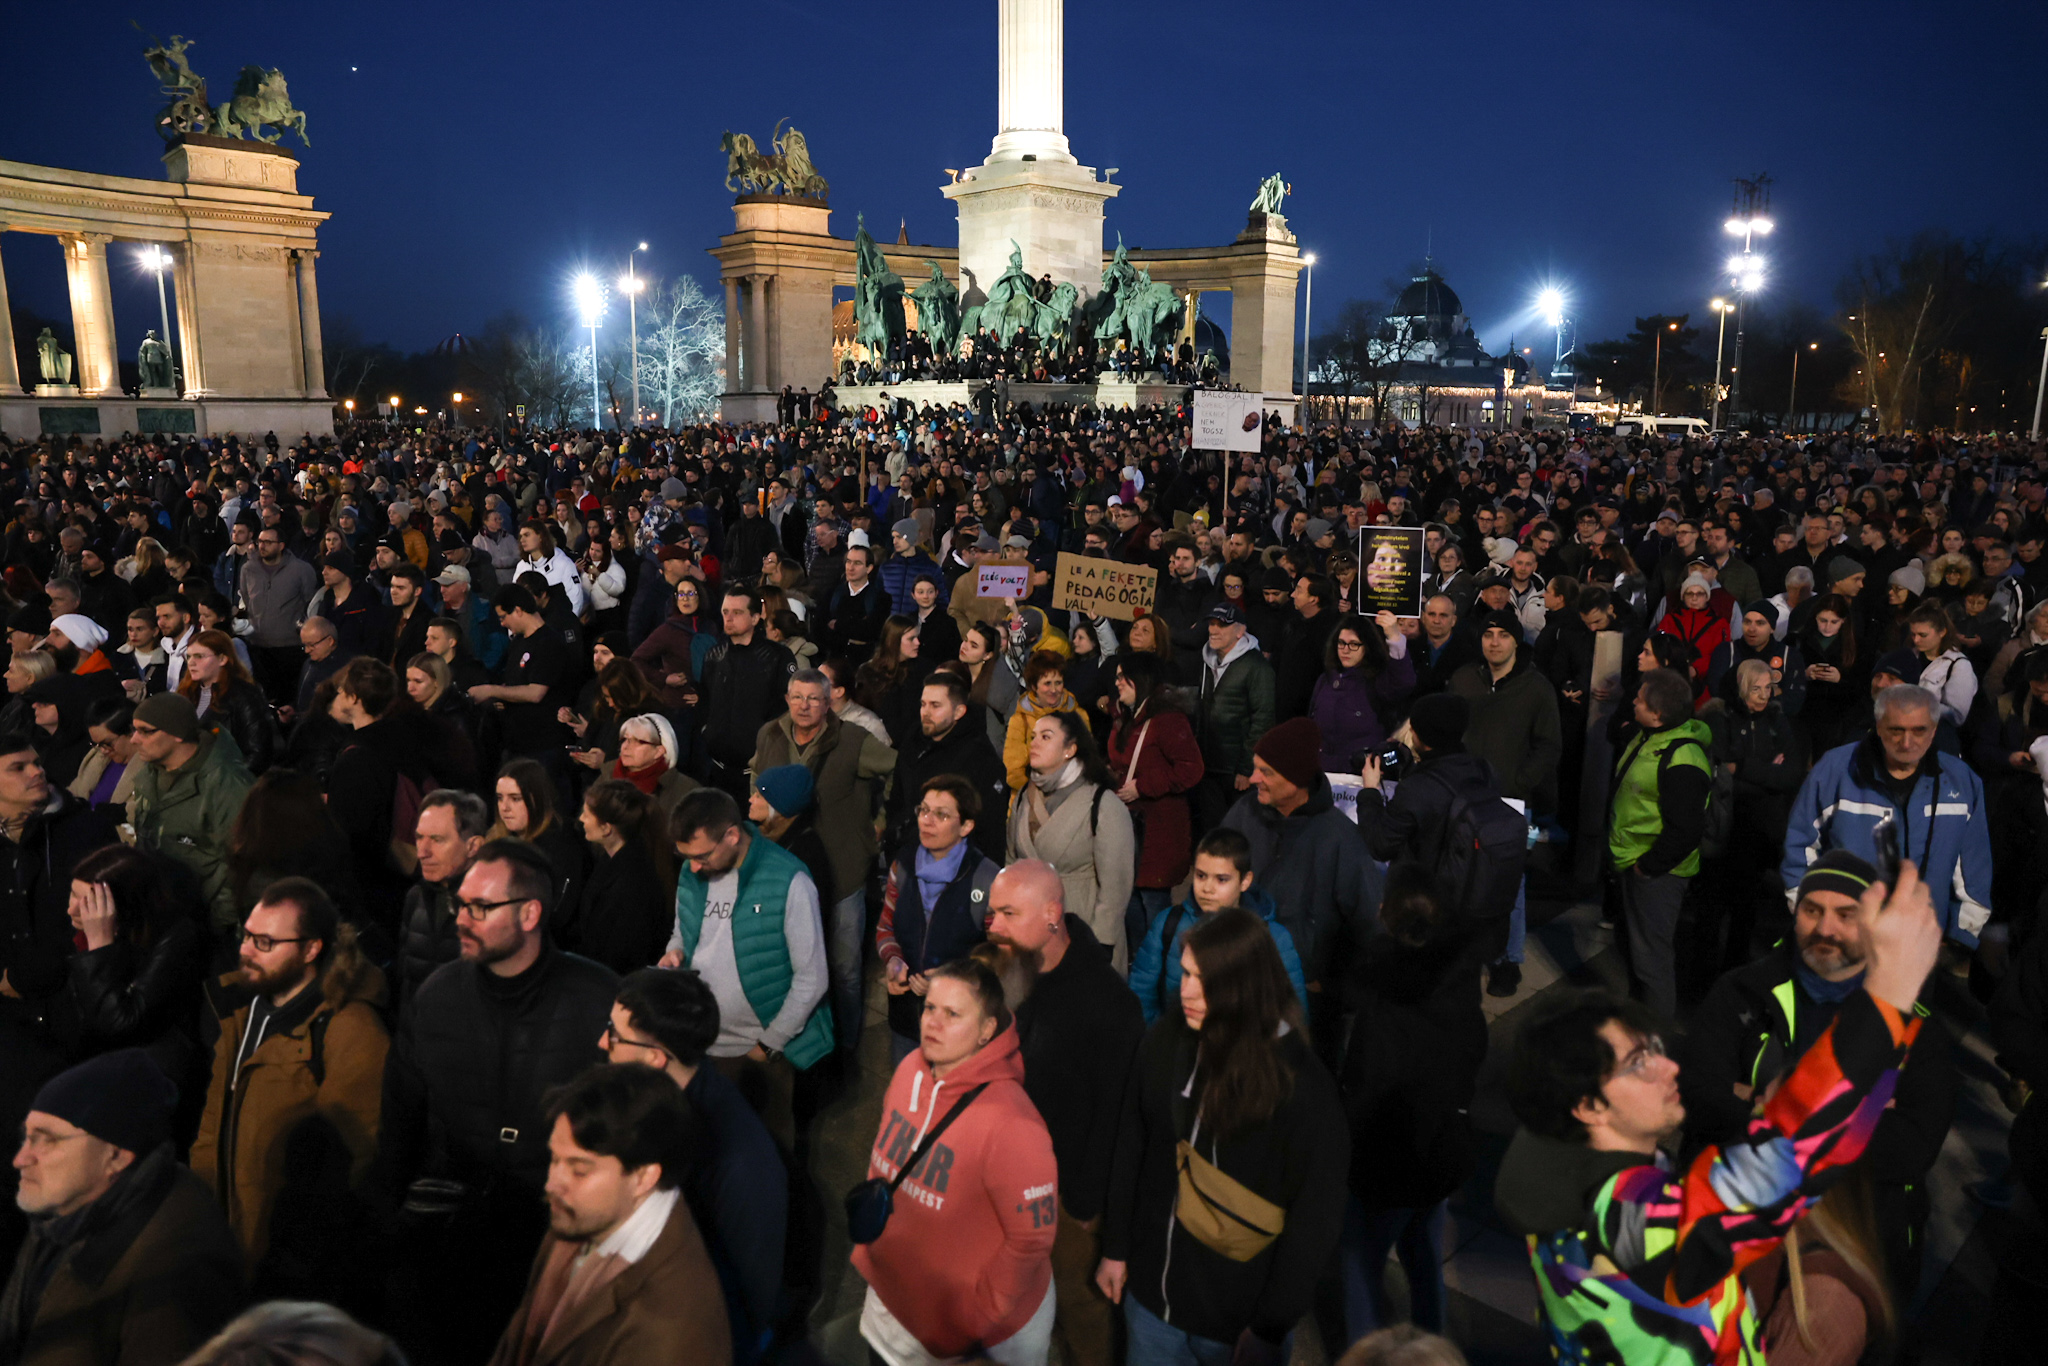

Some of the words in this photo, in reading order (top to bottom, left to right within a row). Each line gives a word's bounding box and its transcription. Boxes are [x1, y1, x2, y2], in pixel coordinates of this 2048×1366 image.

[980, 571, 999, 581] ELÉG
[1000, 576, 1026, 586] VOLT!
[1070, 565, 1082, 576] LE
[1086, 567, 1096, 579] A
[1101, 568, 1155, 588] FEKETE
[703, 900, 733, 919] ZAB
[1023, 1182, 1054, 1200] since
